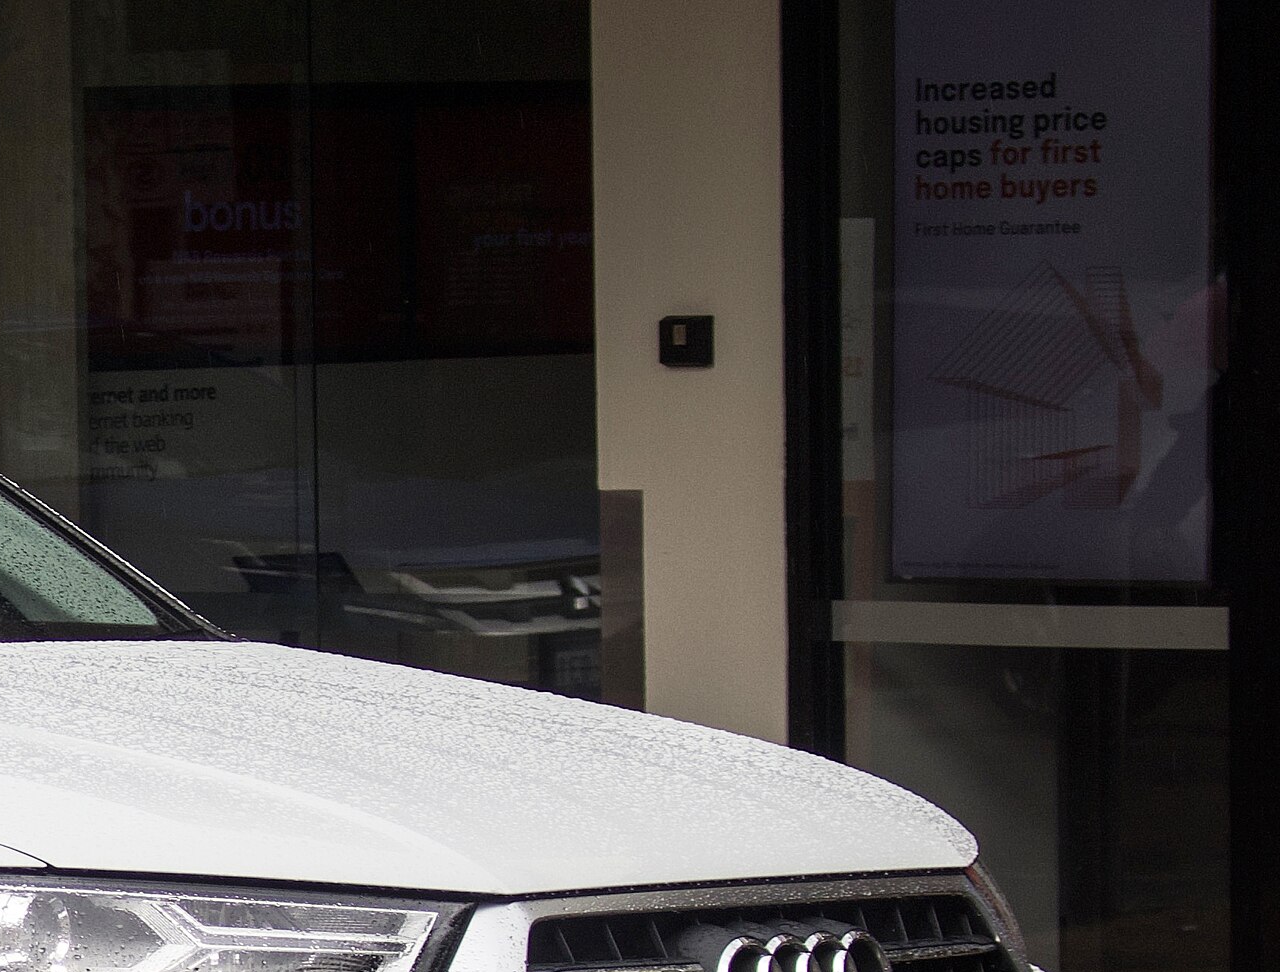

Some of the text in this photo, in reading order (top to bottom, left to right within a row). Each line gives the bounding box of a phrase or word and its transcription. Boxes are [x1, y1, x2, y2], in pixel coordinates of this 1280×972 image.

[915, 72, 1057, 101] Increased
[915, 106, 1108, 140] housing price
[915, 138, 1102, 174] caps for first
[915, 172, 1098, 205] home buyers
[184, 190, 303, 232] bonus
[915, 220, 1081, 237] First Home Guarantee
[138, 383, 169, 402] and
[173, 386, 217, 400] more
[132, 409, 194, 430] banking
[104, 436, 129, 453] the
[133, 434, 166, 452] web
